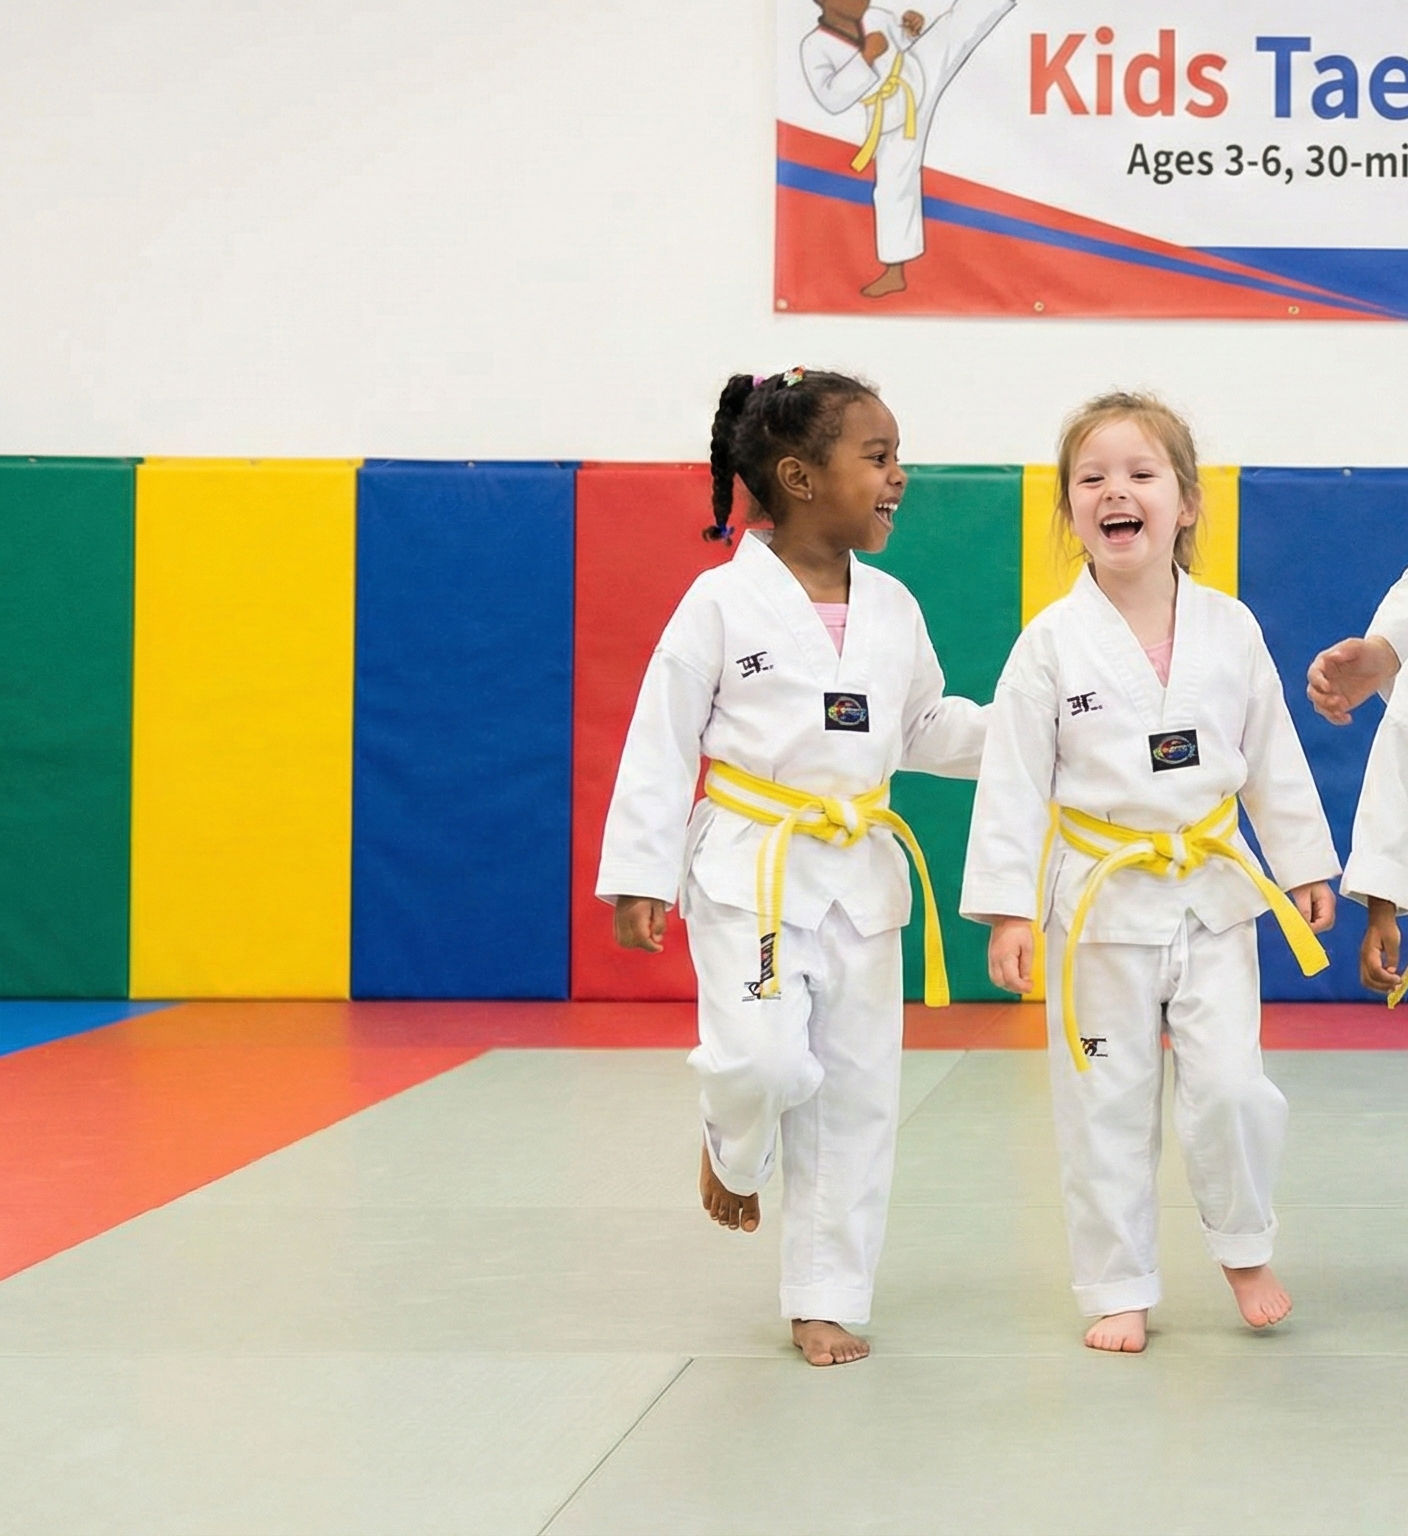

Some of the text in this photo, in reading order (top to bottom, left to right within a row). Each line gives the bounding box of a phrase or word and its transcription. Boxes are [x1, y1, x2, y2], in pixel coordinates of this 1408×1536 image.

[1029, 26, 1229, 118] Kids
[1126, 143, 1214, 185] Ages
[1224, 144, 1294, 185] 3-6,
